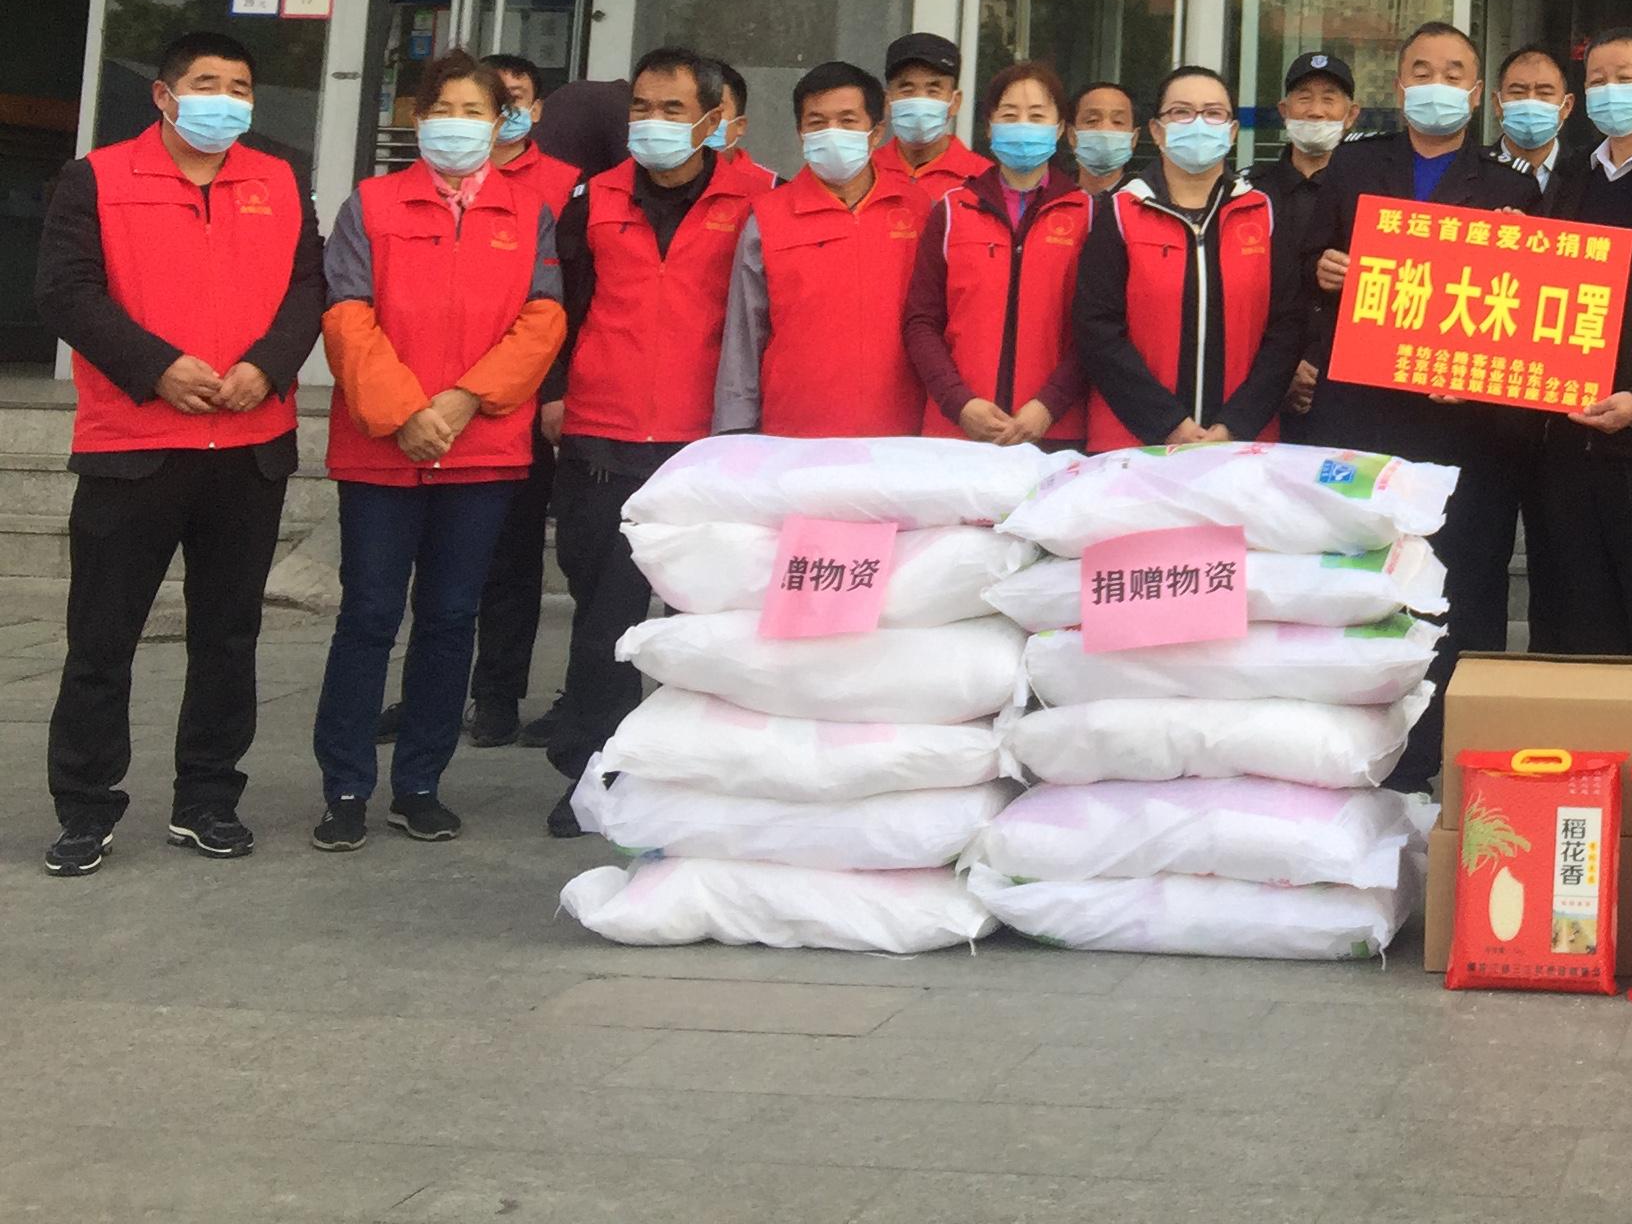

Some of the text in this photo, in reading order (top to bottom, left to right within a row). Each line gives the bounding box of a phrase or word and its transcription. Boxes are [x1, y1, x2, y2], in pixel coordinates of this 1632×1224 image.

[1376, 208, 1612, 263] 联运首座爱心捐赠
[1352, 255, 1612, 355] 面粉 大米 口罩
[1090, 559, 1238, 607] 捐赠物资
[1560, 818, 1587, 886] 稻花香
